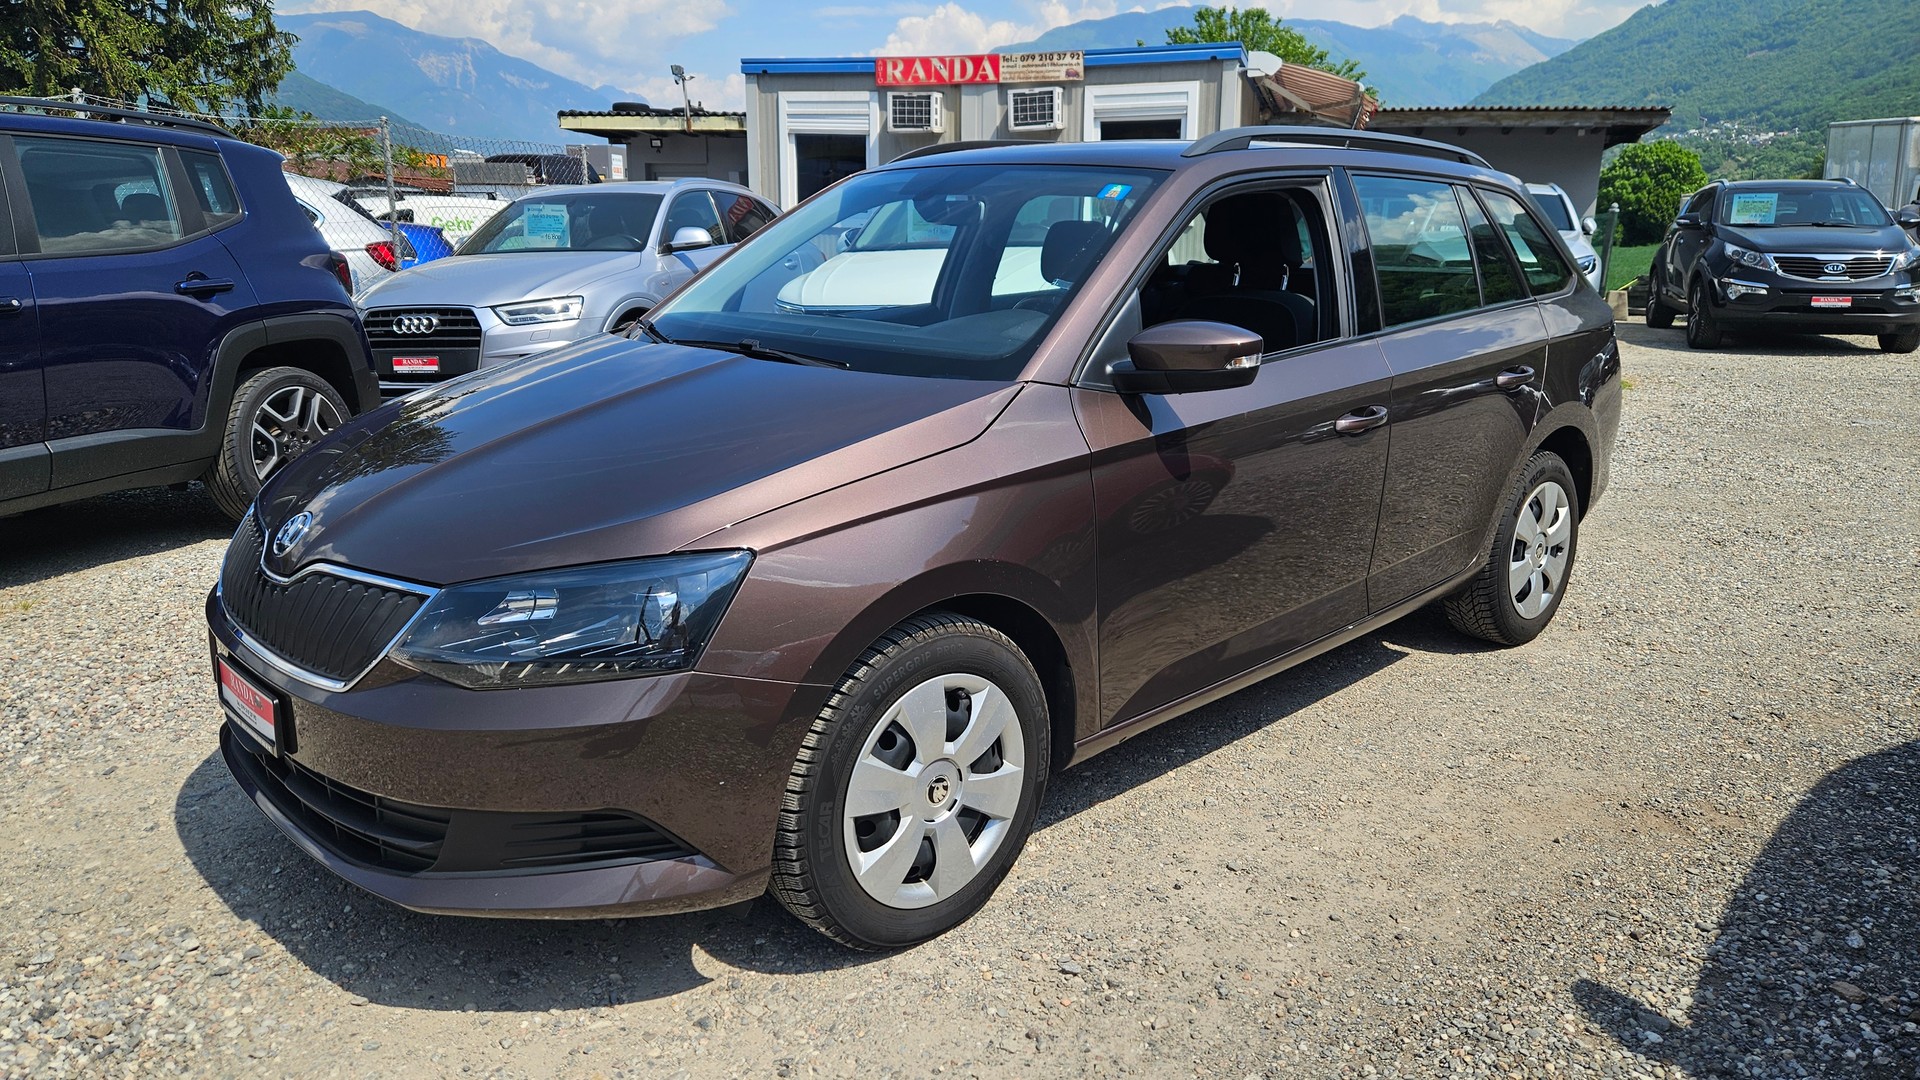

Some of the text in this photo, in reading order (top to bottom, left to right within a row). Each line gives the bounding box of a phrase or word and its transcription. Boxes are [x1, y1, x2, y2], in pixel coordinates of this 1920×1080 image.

[885, 56, 998, 83] RANDA
[1020, 54, 1036, 62] 079
[1038, 53, 1054, 61] 210
[1056, 52, 1067, 60] 37
[1069, 52, 1080, 60] 92
[229, 672, 255, 706] RANDA
[873, 651, 931, 700] SUPERGRIP
[1038, 727, 1047, 782] TECAR
[817, 800, 834, 863] TECAR
